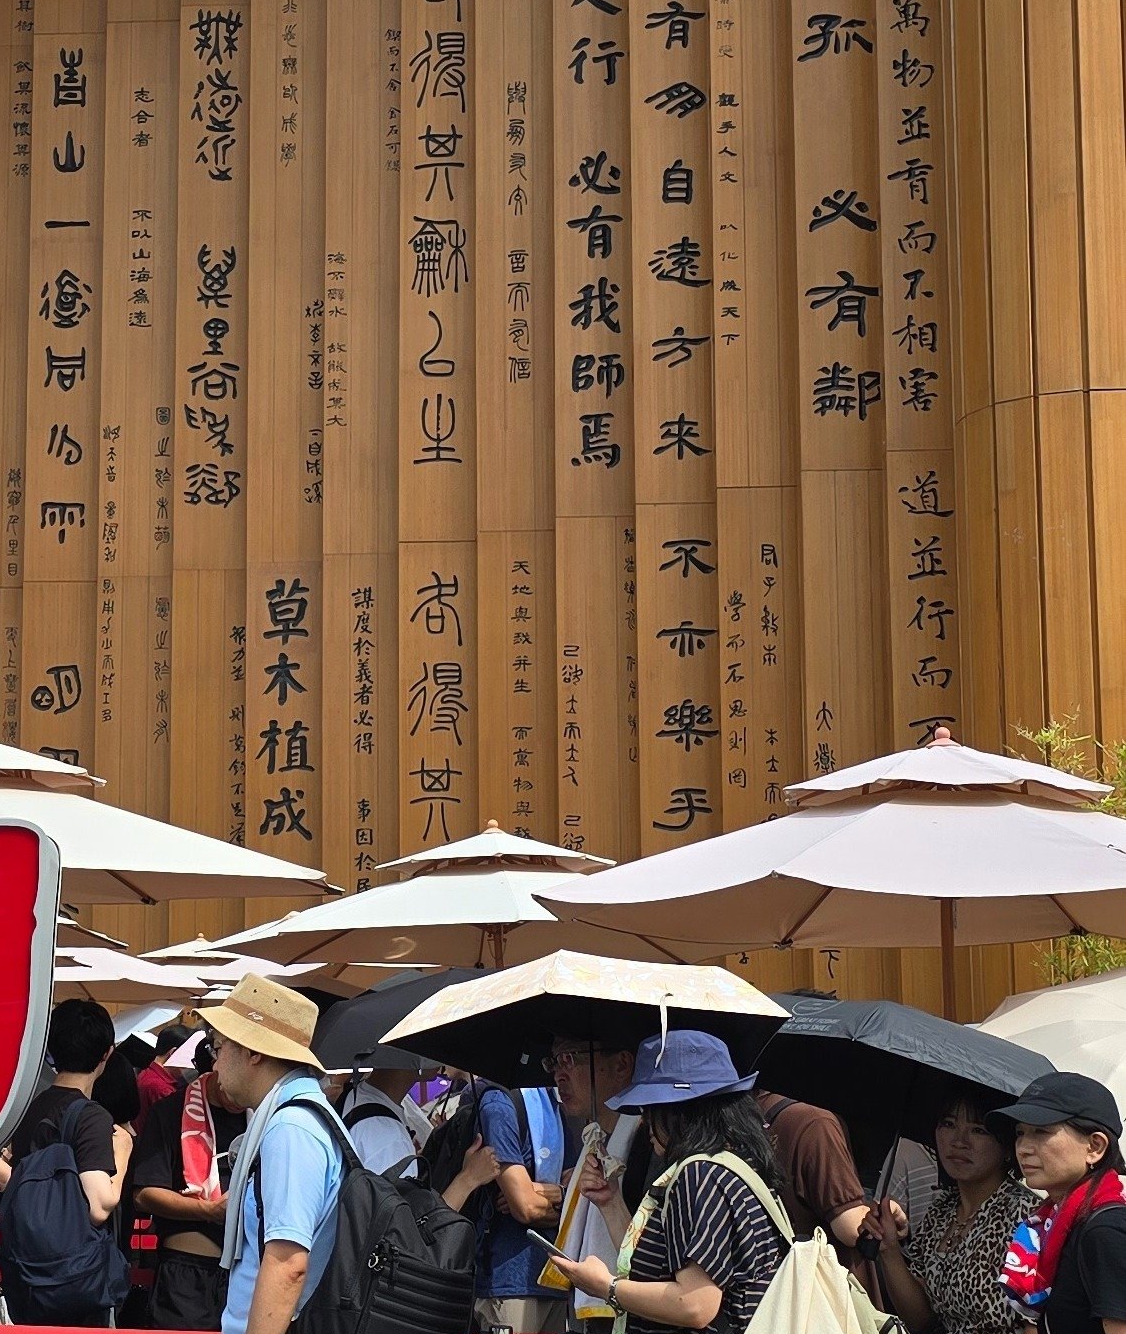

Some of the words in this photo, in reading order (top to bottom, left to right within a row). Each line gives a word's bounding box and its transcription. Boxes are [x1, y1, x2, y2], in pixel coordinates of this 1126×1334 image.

[566, 151, 626, 469] 必有我師焉
[643, 1, 714, 463] 有朋自遠方來
[805, 187, 884, 423] 必有鄰
[255, 578, 316, 842] 草木植成
[351, 586, 375, 755] 謀度於義者必得
[651, 538, 722, 834] 不亦樂乎
